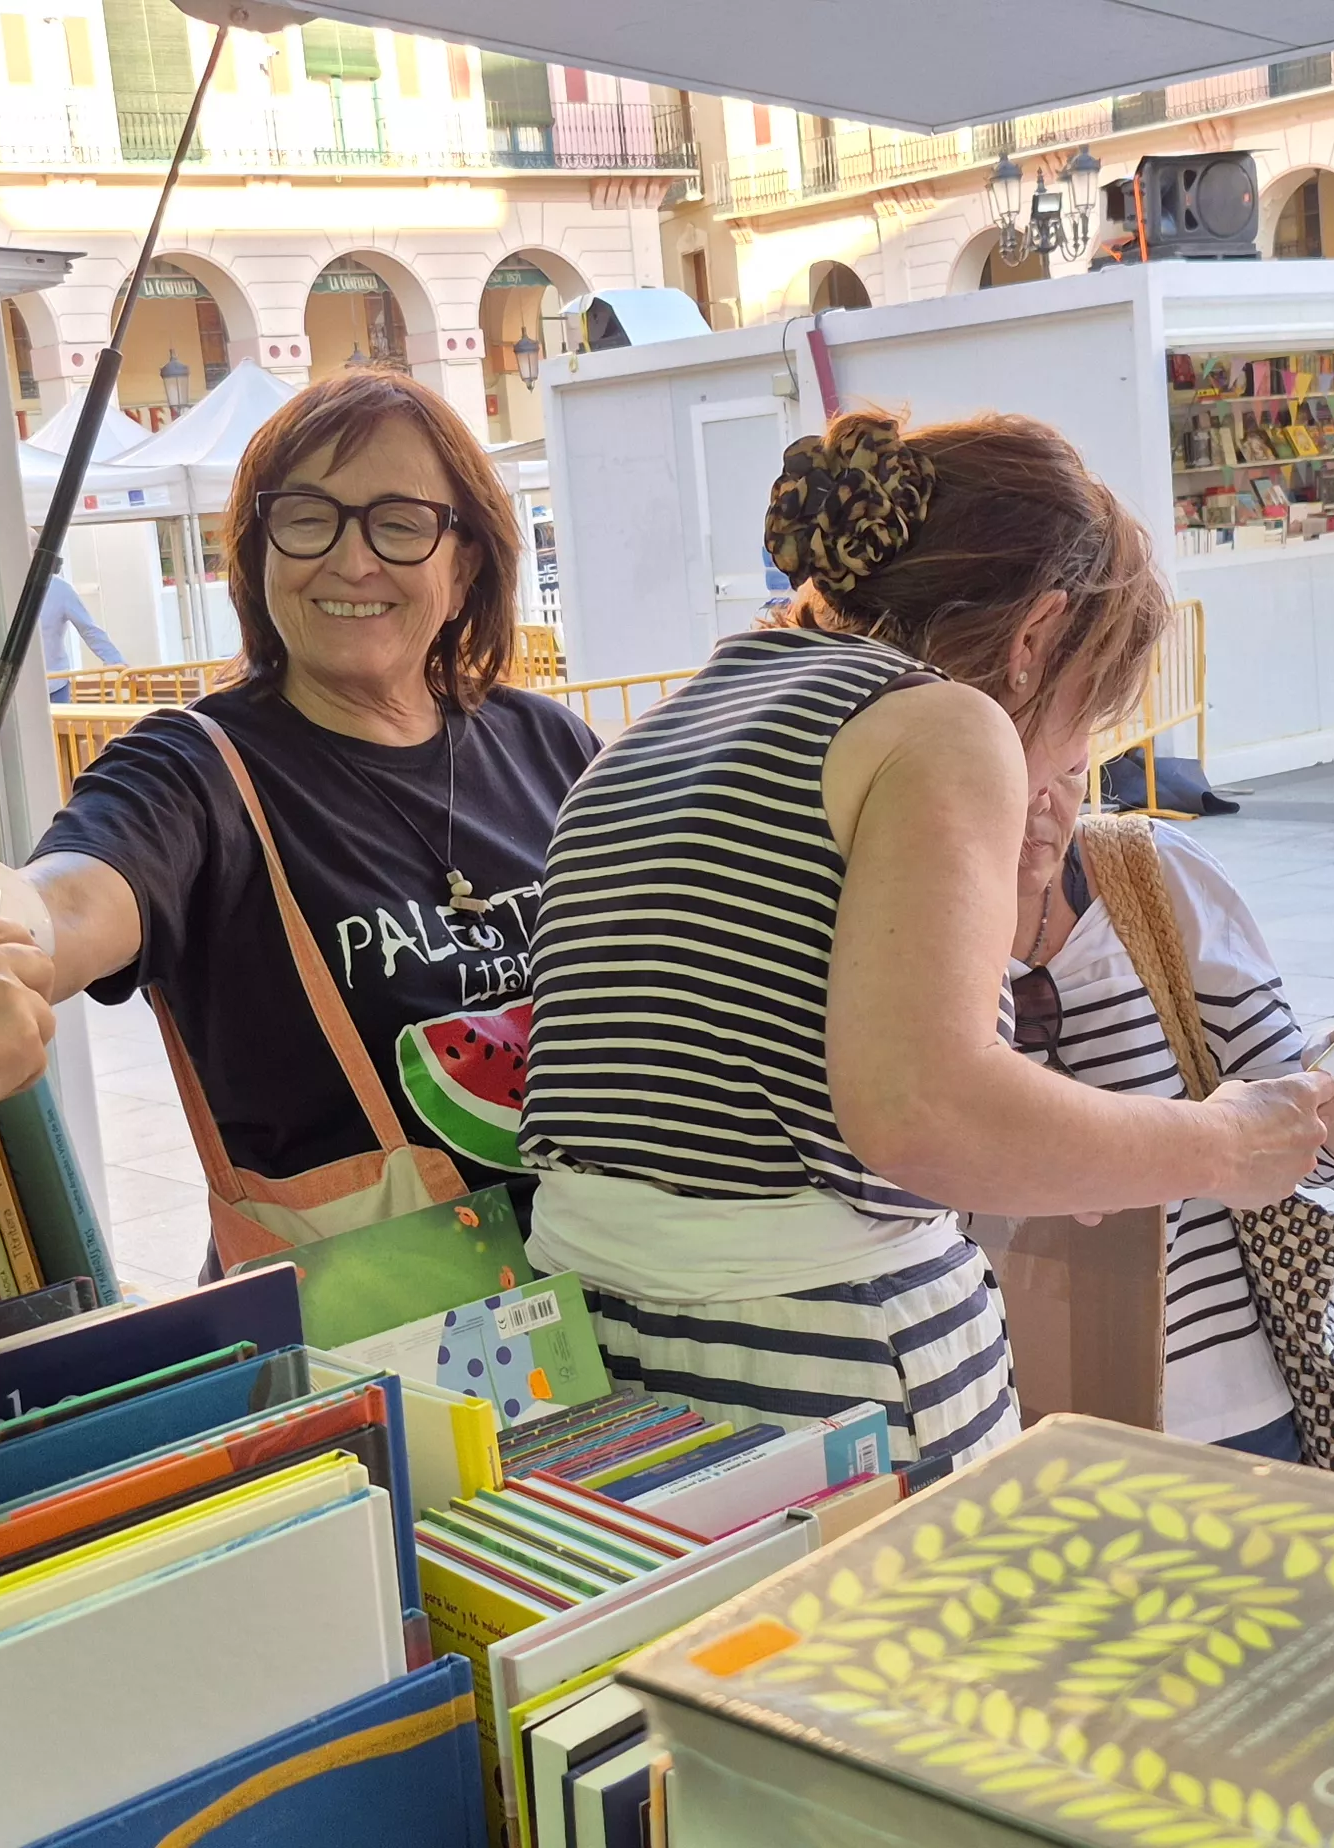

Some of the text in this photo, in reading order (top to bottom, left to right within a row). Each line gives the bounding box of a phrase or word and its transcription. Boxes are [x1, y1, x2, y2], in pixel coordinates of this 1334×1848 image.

[155, 277, 198, 296] CONFIANZA
[340, 274, 379, 290] CONFIANZA
[51, 1122, 60, 1134] de
[54, 1134, 66, 1156] Vicky
[424, 1591, 442, 1609] para
